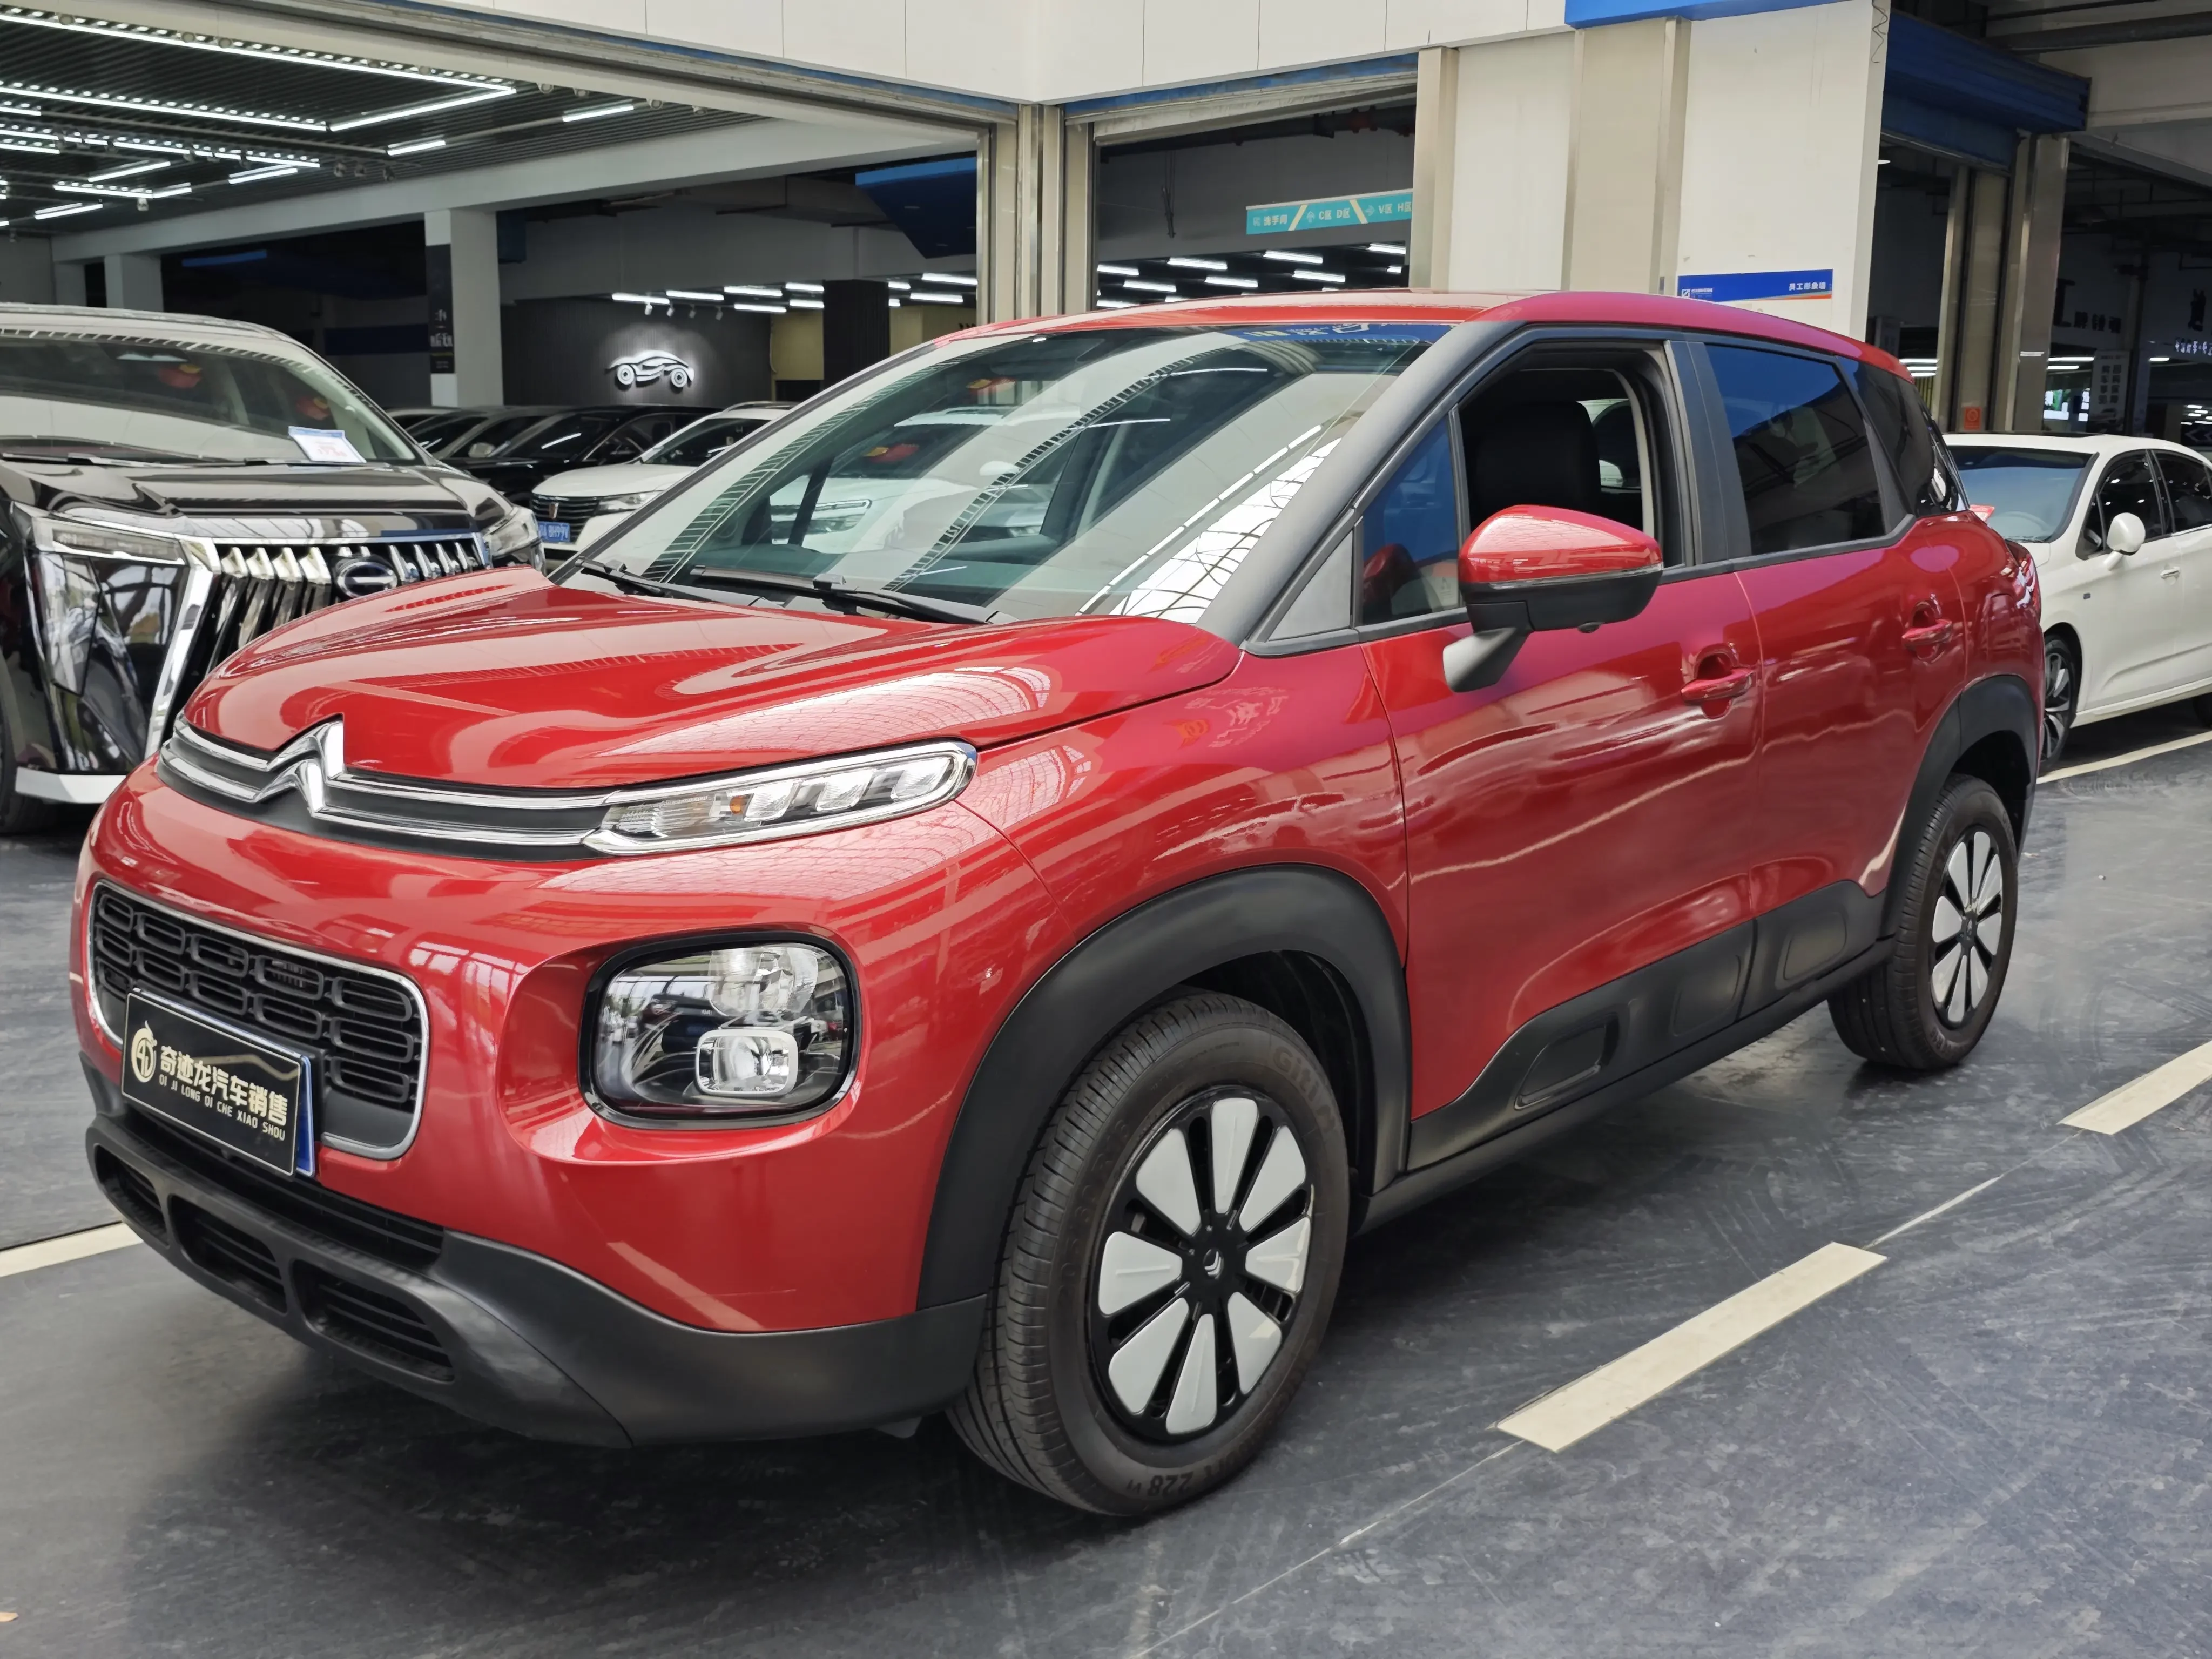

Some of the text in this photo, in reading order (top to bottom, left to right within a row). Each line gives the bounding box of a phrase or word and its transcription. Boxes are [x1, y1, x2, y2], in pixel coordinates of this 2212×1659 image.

[1264, 214, 1288, 226] 洗手间
[1319, 207, 1351, 220] C区 D区
[1378, 203, 1393, 214] V区
[160, 1045, 288, 1126] 奇迹龙汽车销售
[1273, 1046, 1319, 1103] Giti
[171, 1080, 178, 1091] JI
[181, 1084, 201, 1102] LONG
[217, 1101, 233, 1117] CHE
[237, 1110, 258, 1129] XIAO
[262, 1121, 286, 1141] SHOU
[1147, 1470, 1195, 1498] 228
